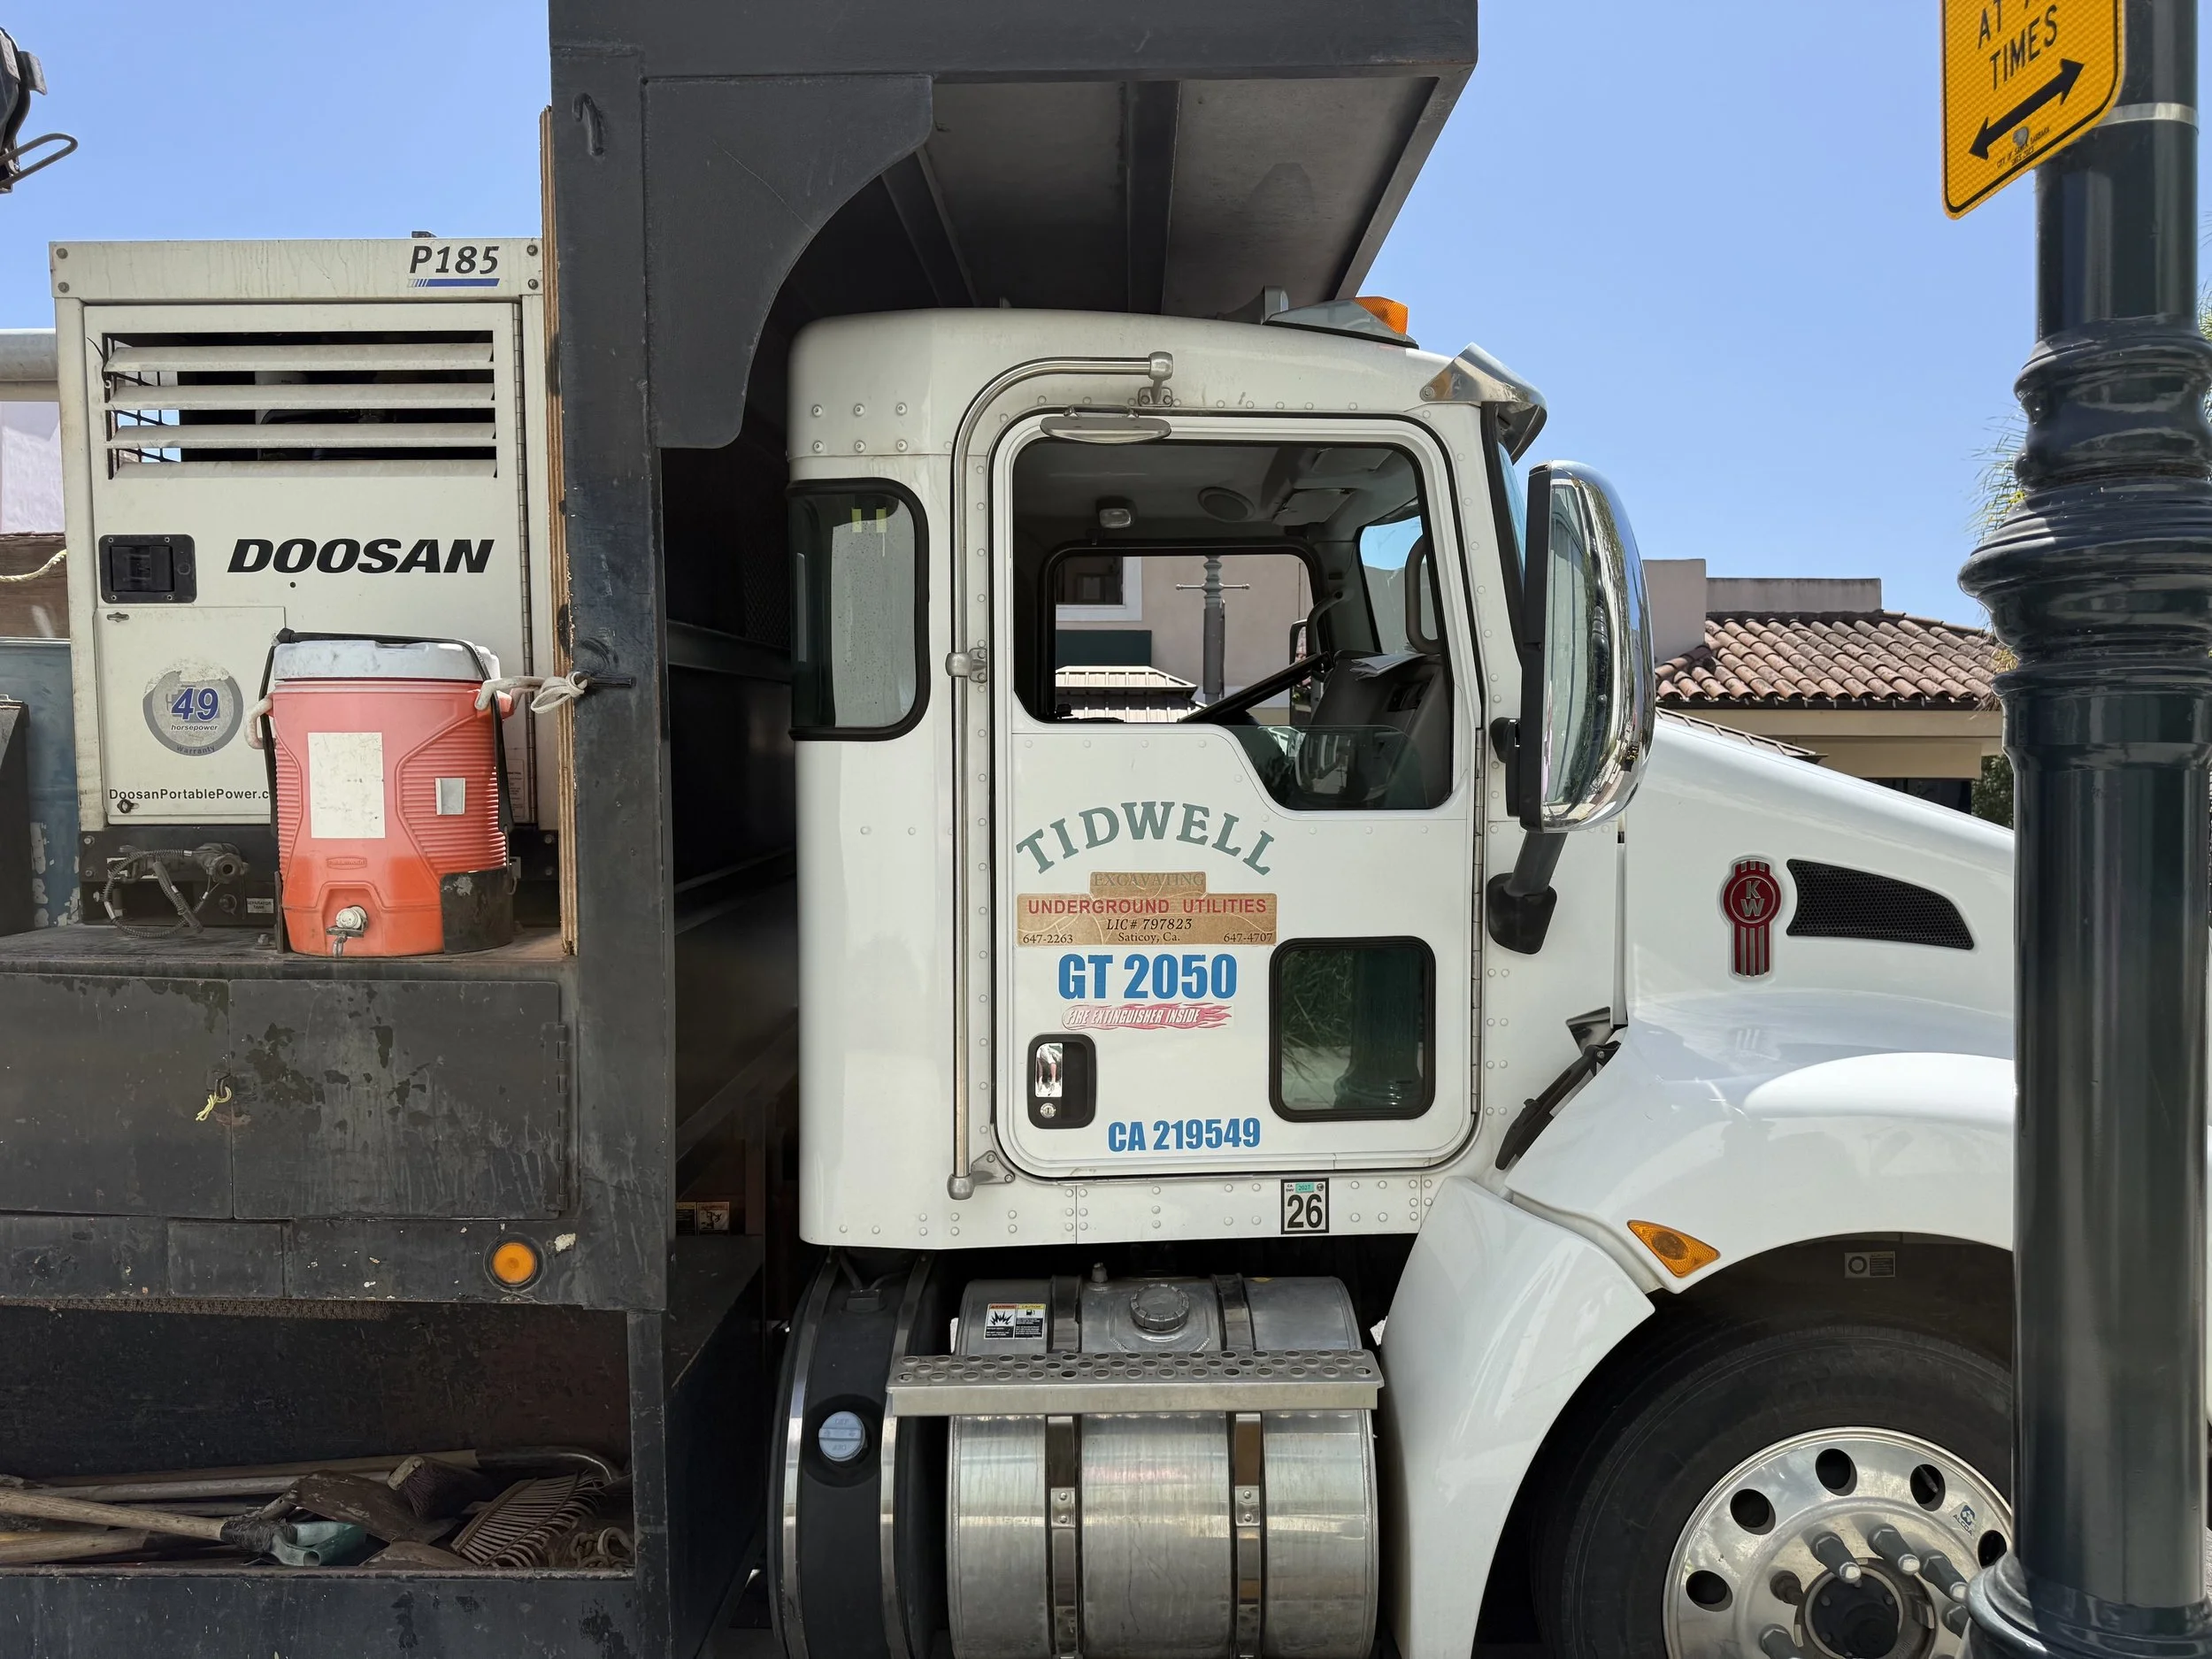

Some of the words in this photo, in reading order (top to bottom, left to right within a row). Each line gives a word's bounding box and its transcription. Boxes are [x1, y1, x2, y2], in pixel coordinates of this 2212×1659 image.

[1978, 0, 2001, 50] AT
[1990, 4, 2057, 90] TIMES
[409, 245, 500, 274] P185
[227, 538, 495, 573] DOOSAN
[171, 687, 219, 721] 49
[176, 745, 215, 755] Warranty
[109, 788, 269, 800] DoosanPortablePower.c
[1016, 801, 1275, 876] TIDWELL
[1094, 873, 1203, 887] EXCAVATING
[1028, 900, 1169, 914] UNDERGROUND
[1183, 898, 1266, 913] UTILITIES
[1740, 880, 1764, 917] KW
[1143, 918, 1192, 930] 797823
[1023, 933, 1073, 944] 647-2263
[1118, 932, 1159, 943] Saticoy,
[1163, 932, 1180, 941] Ca.
[1223, 933, 1272, 942] 647-4707
[1059, 954, 1113, 999] GT
[1124, 954, 1237, 999] 2050
[1067, 1010, 1090, 1025] FIRE
[1091, 1010, 1165, 1024] EXTINGUISHER
[1165, 1009, 1200, 1023] INSIDE
[1109, 1122, 1147, 1152] CA
[1153, 1118, 1260, 1150] 219549
[1287, 1194, 1323, 1228] 26
[1953, 1514, 1972, 1536] ALCOA
